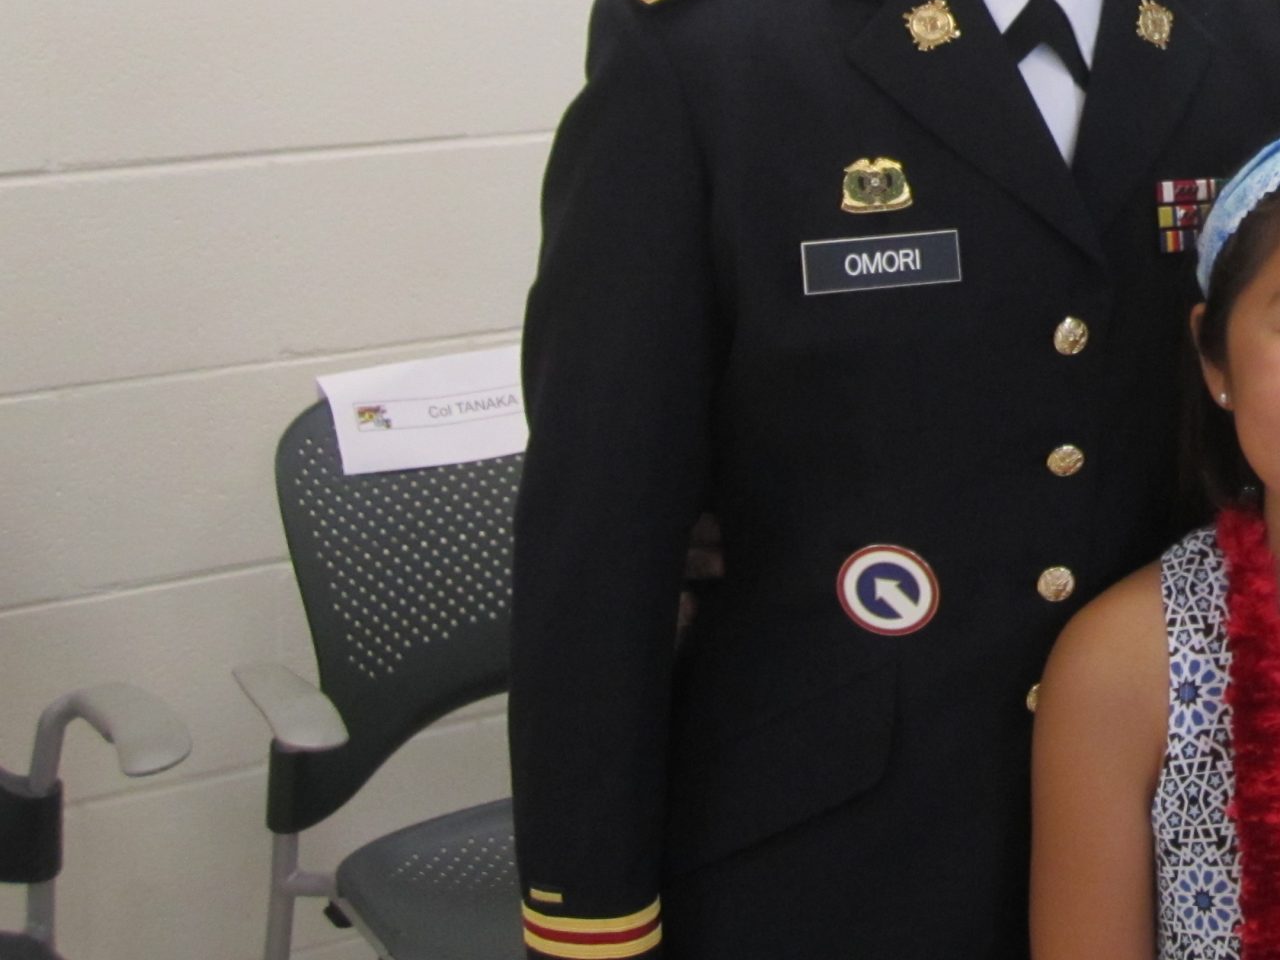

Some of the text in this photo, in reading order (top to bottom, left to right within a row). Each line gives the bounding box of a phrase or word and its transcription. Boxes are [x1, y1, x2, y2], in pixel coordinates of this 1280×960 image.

[844, 248, 921, 276] OMORI
[428, 393, 519, 419] Col TANAKA
